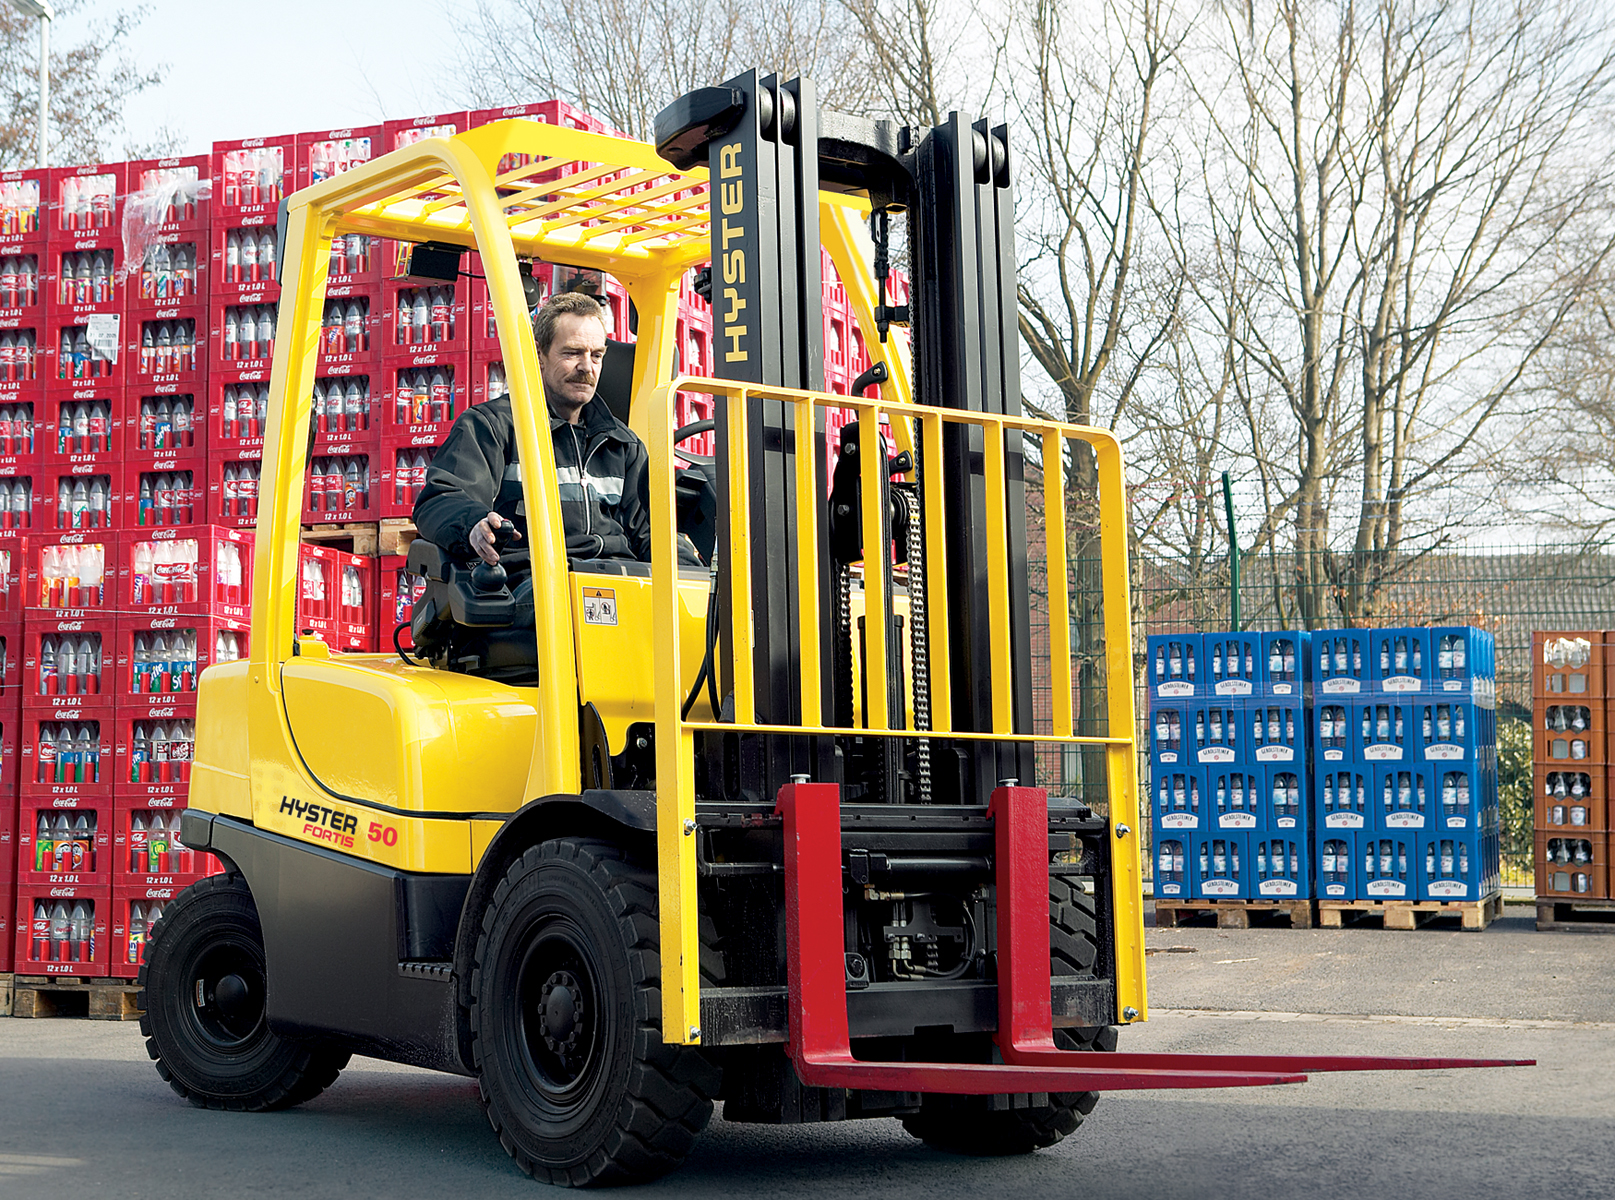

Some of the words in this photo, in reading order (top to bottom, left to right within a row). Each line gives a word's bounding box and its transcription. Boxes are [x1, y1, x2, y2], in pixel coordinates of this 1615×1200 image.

[720, 142, 748, 363] HYSTER
[0, 392, 19, 400] oca-Cola
[0, 466, 17, 475] oca-Cola
[279, 795, 358, 835] HYSTER
[302, 823, 355, 848] FORTIS
[367, 821, 398, 847] 50
